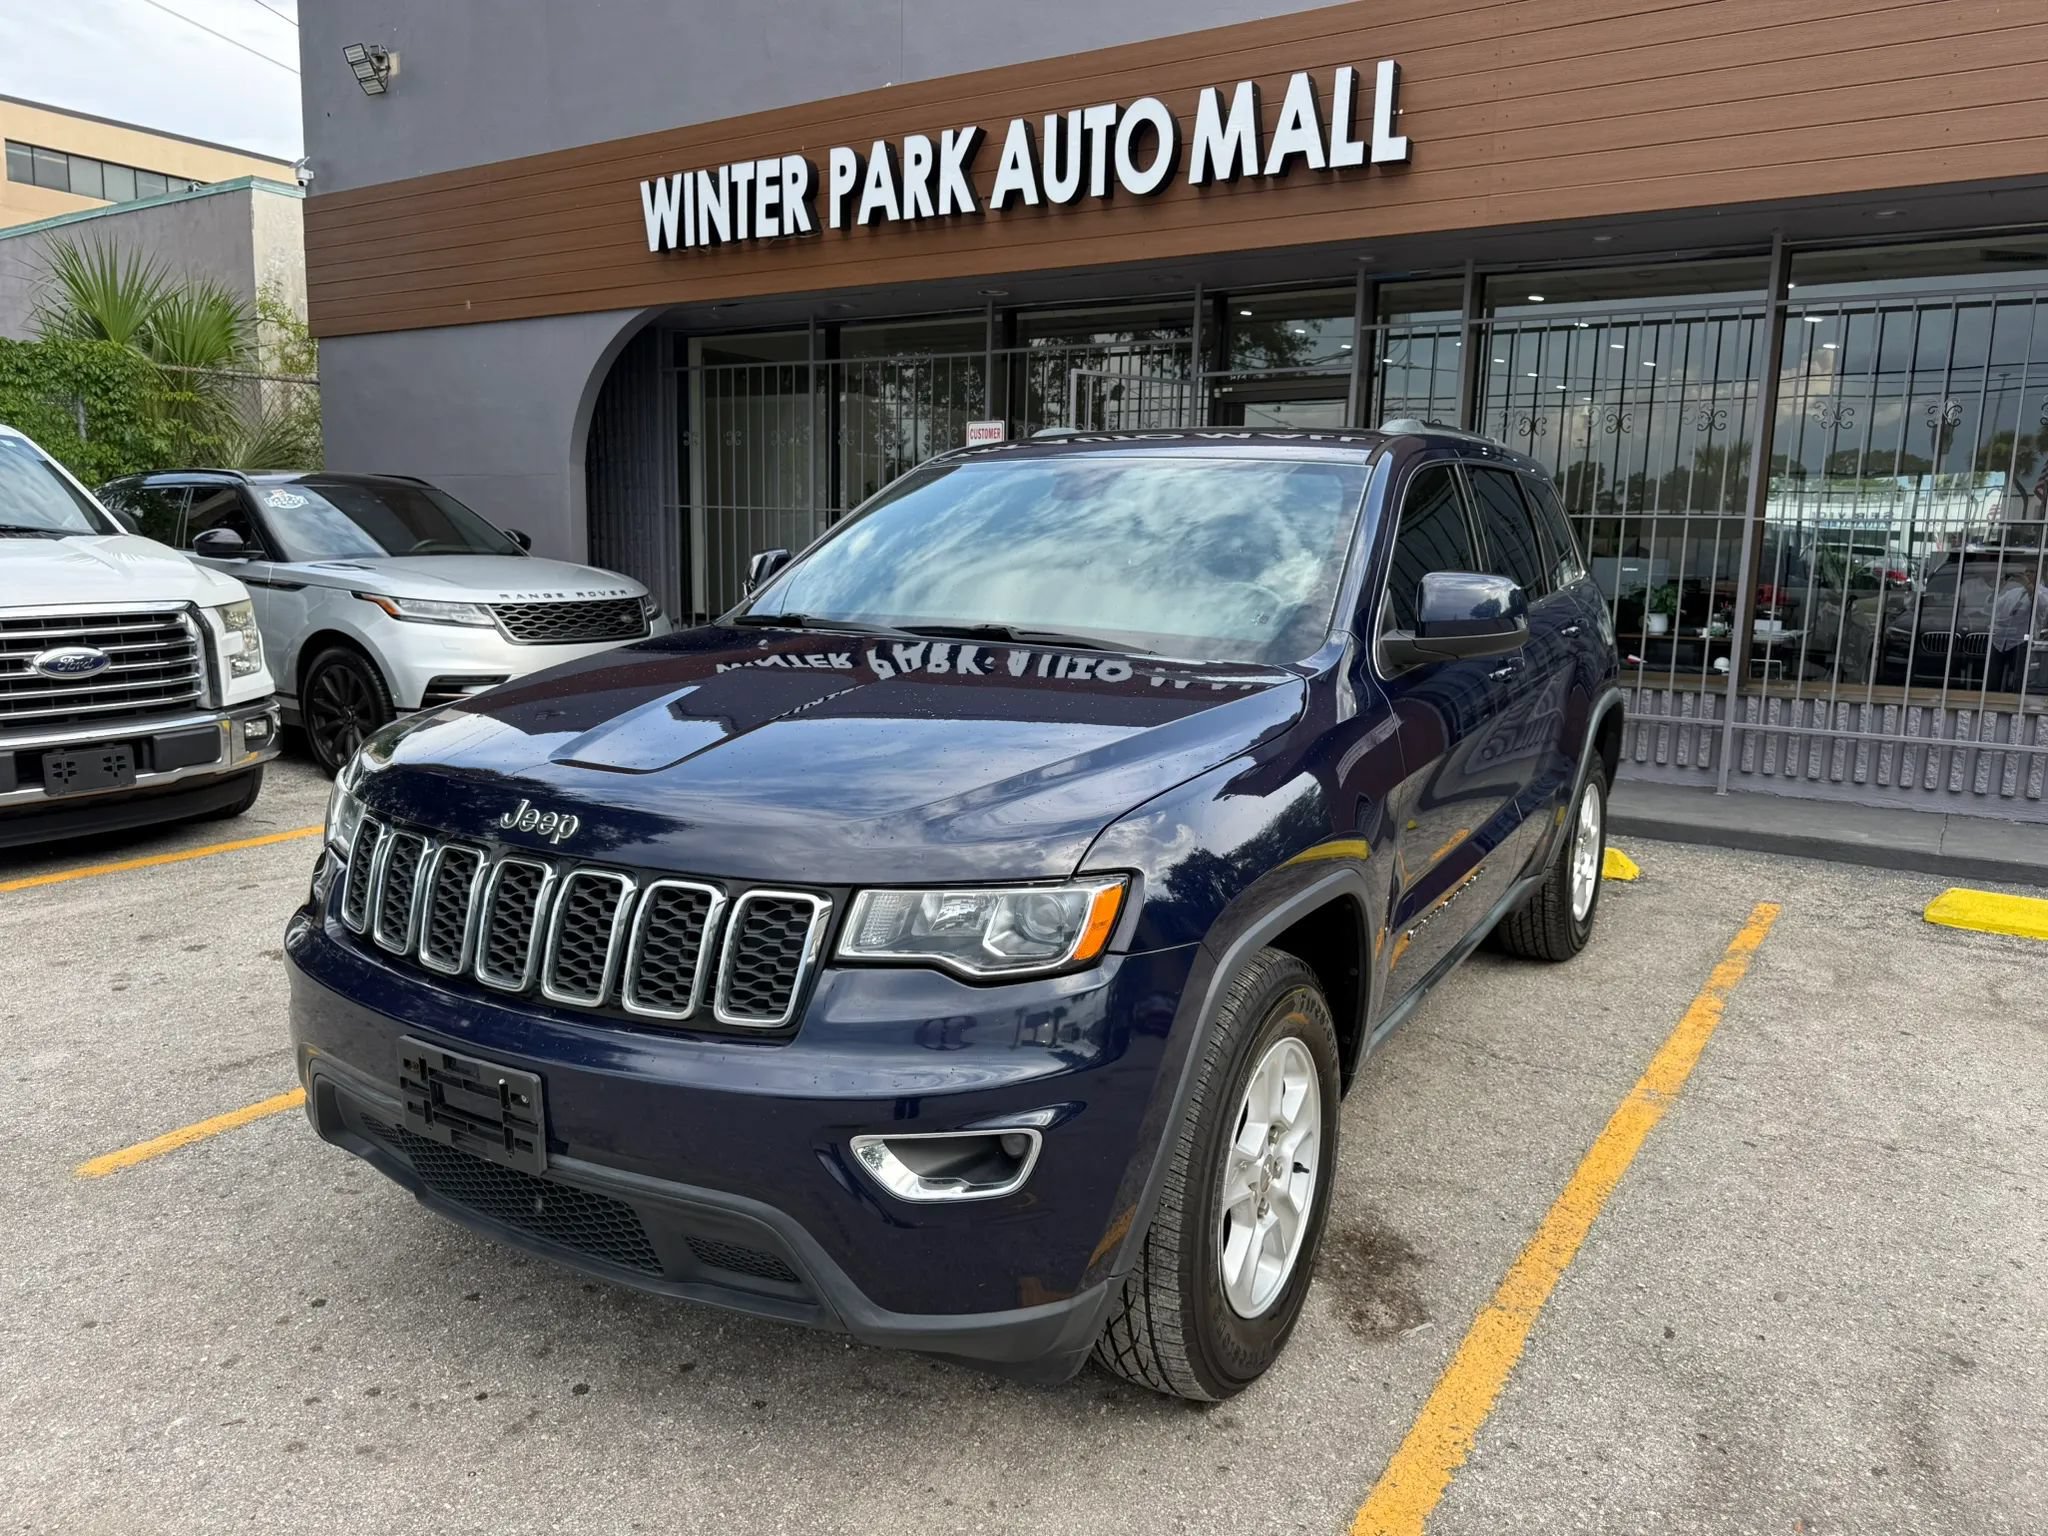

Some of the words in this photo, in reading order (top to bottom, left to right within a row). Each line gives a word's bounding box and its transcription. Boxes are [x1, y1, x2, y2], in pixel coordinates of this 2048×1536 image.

[640, 154, 814, 252] WINTER
[829, 126, 979, 228] PARK
[989, 97, 1174, 209] AUTO
[1188, 59, 1408, 185] MALL
[970, 427, 1001, 440] CUSTOMER
[576, 590, 627, 598] ROVER
[57, 655, 94, 671] Ford
[500, 799, 579, 844] Jeep
